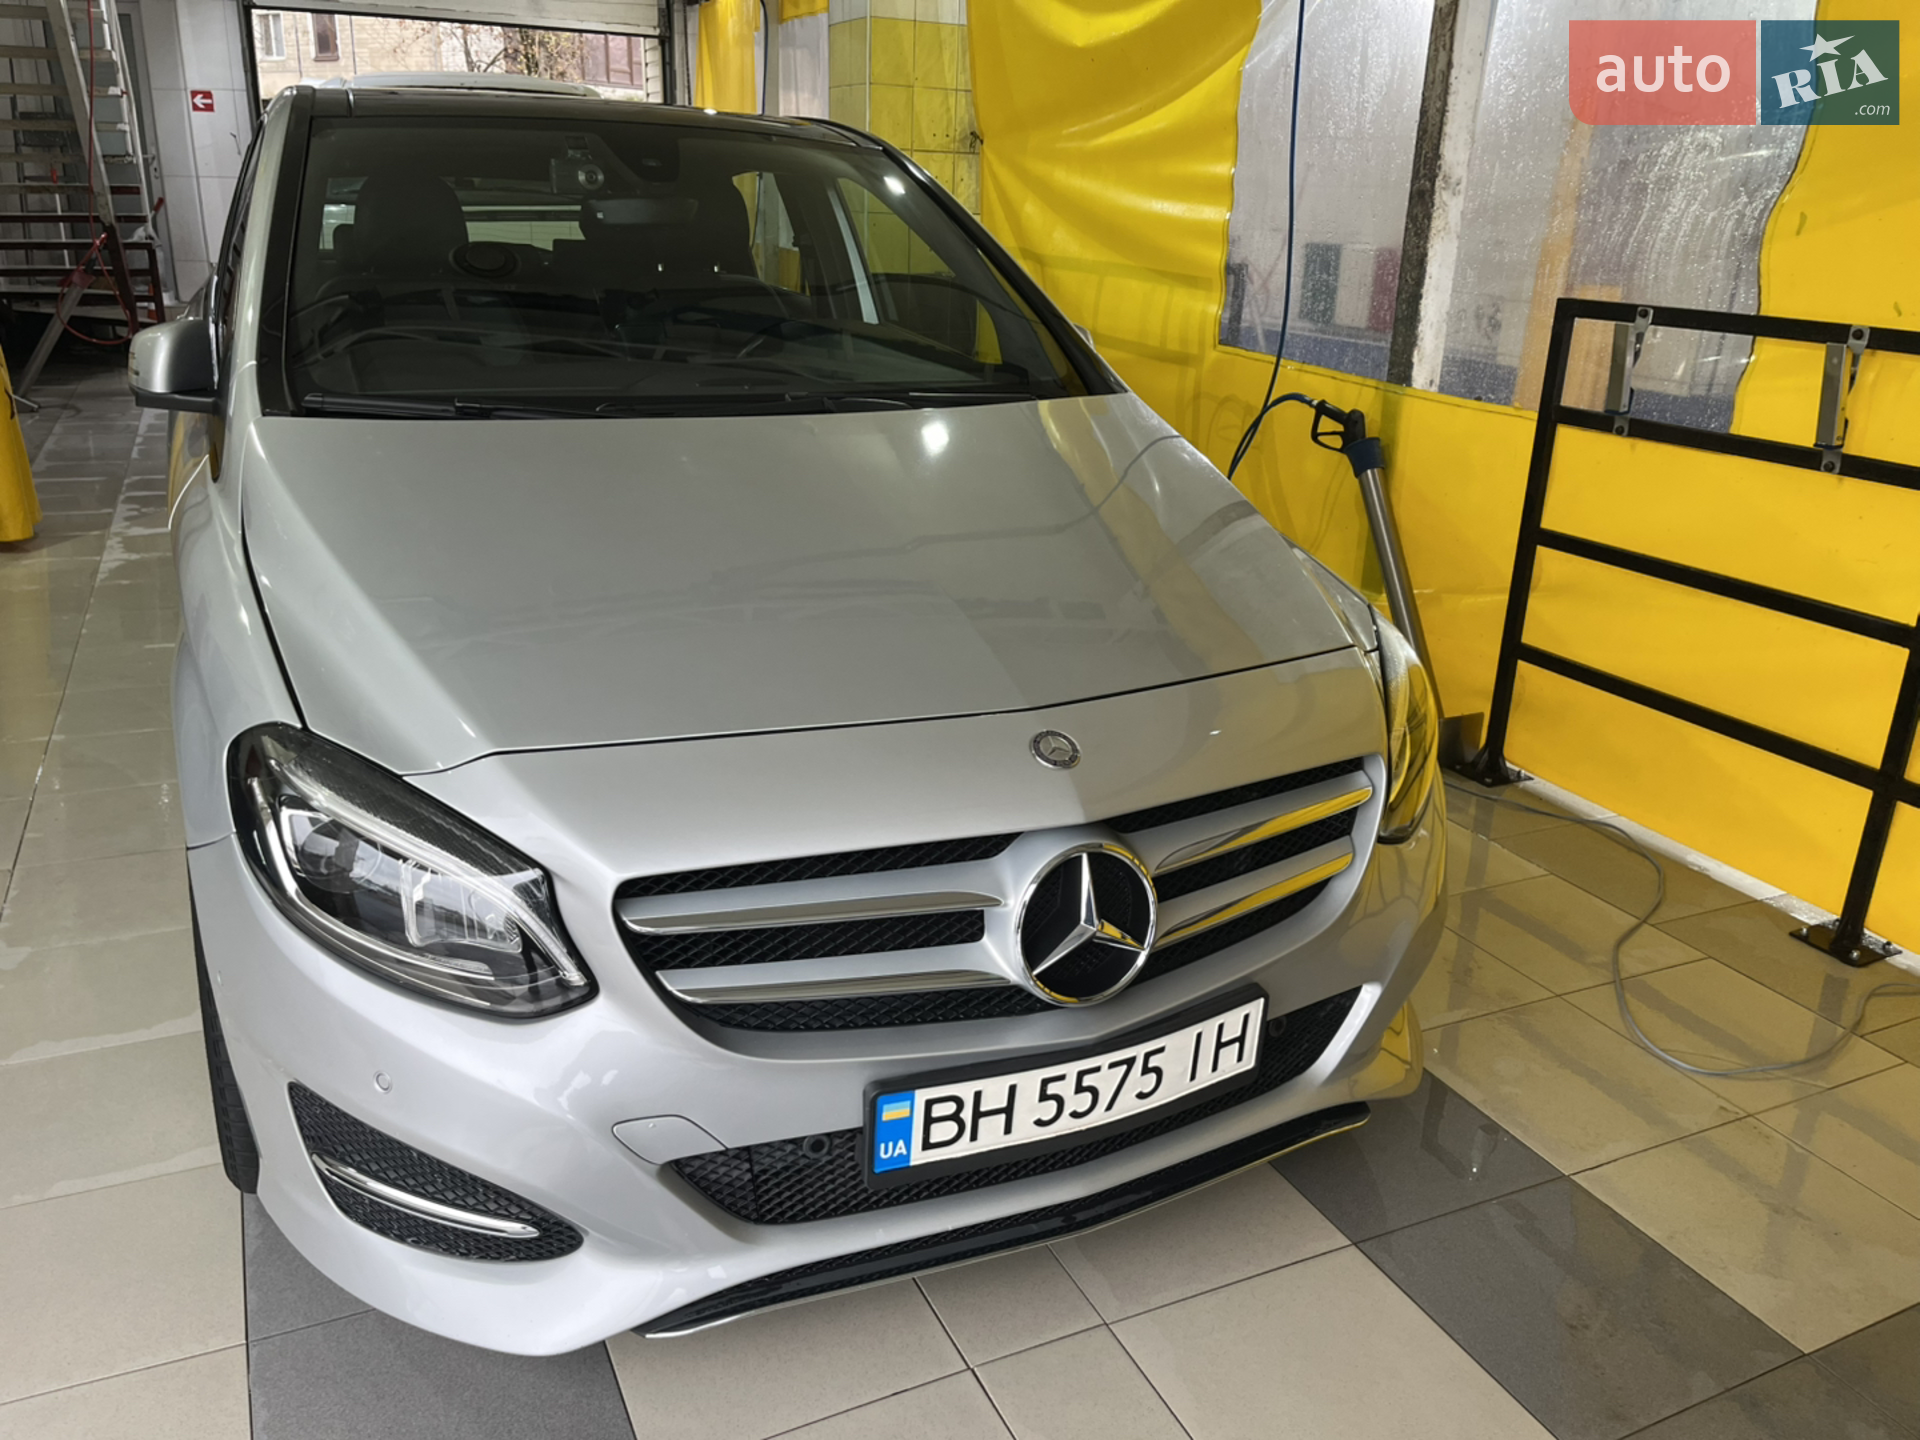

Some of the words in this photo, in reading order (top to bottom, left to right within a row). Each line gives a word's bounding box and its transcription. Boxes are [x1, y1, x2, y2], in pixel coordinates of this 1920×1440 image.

[921, 1083, 1018, 1152] BH
[1032, 1045, 1166, 1128] 5575
[1188, 1012, 1251, 1084] IH
[879, 1139, 908, 1160] UA
